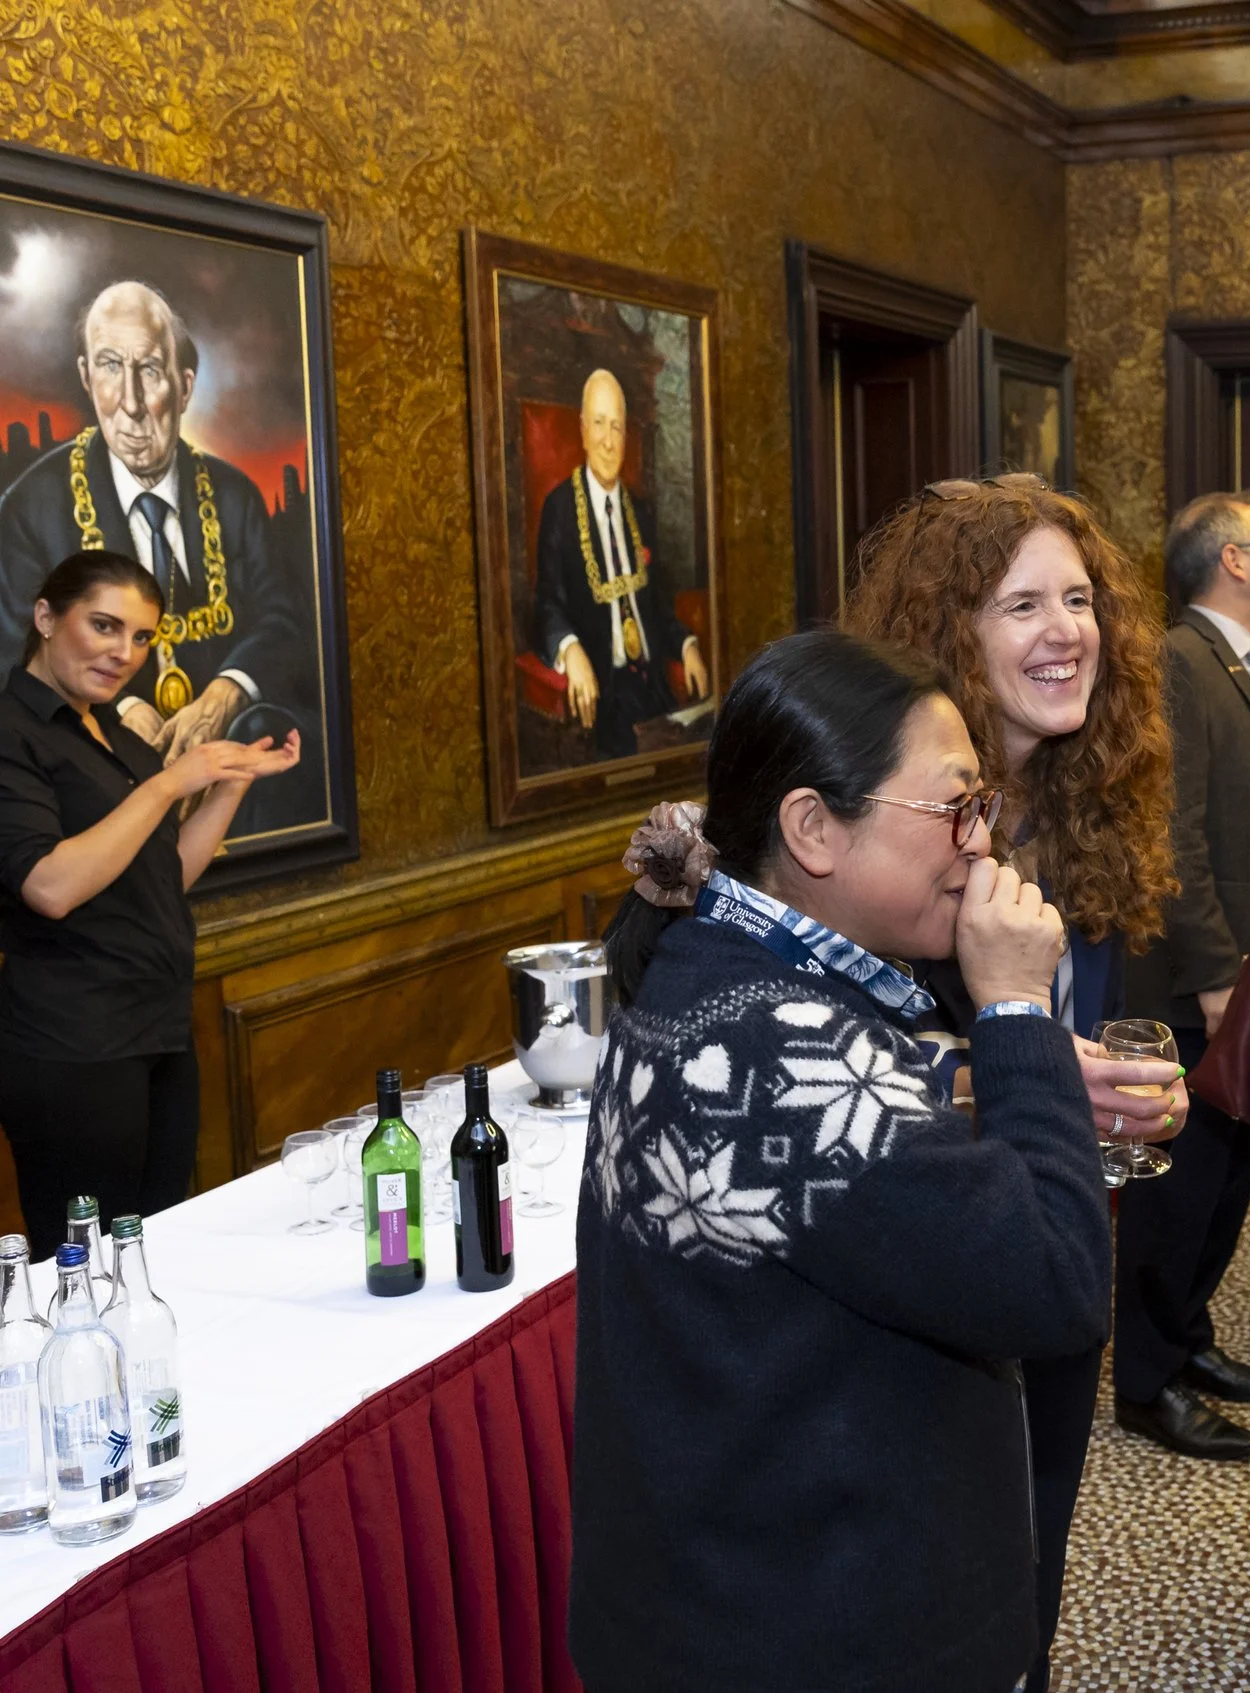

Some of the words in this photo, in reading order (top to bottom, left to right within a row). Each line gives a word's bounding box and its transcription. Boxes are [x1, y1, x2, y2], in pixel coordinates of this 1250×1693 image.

[723, 911, 733, 923] of
[731, 914, 769, 938] Glasgow
[729, 901, 775, 930] University
